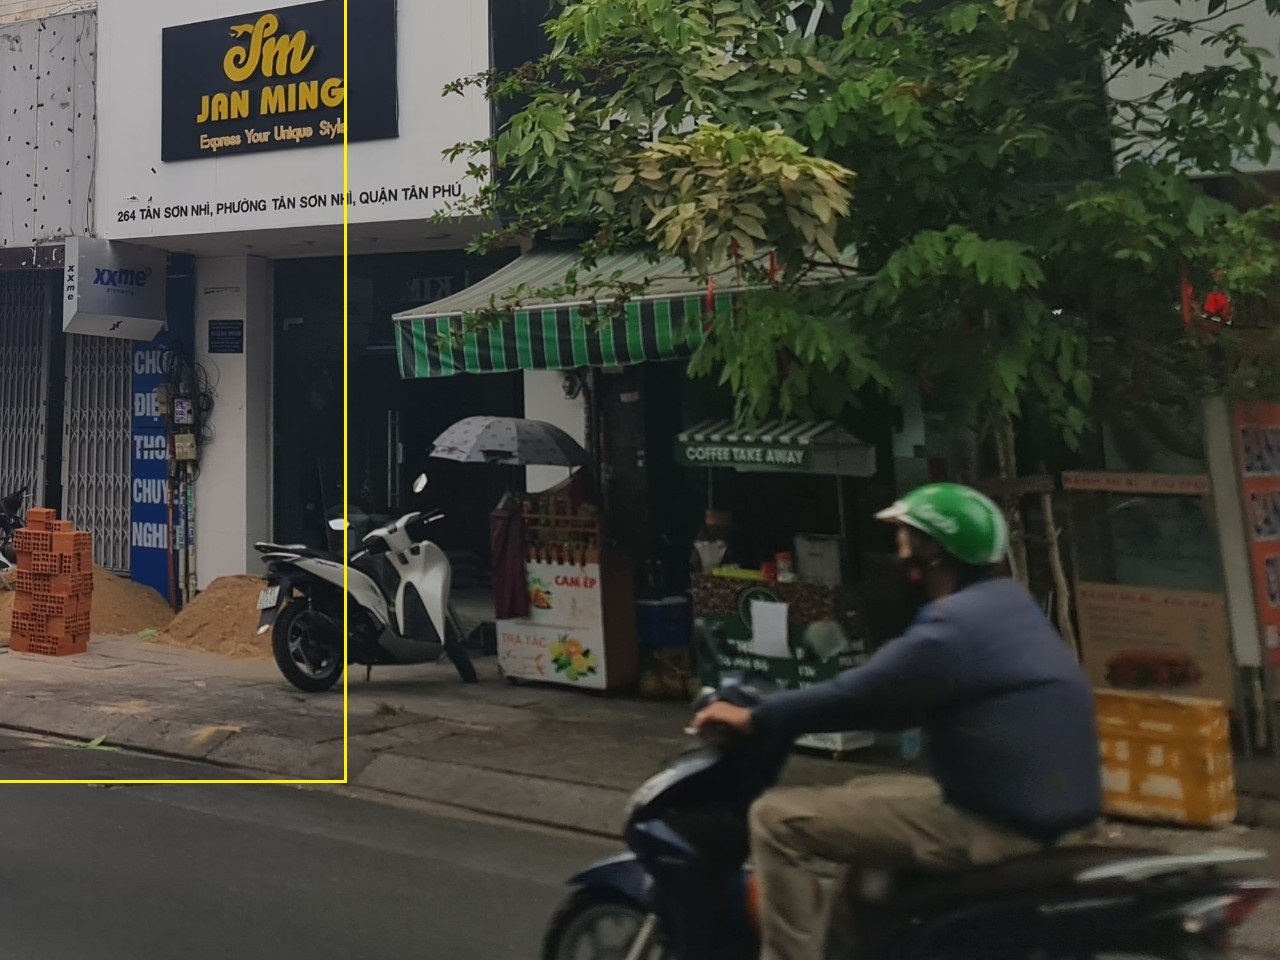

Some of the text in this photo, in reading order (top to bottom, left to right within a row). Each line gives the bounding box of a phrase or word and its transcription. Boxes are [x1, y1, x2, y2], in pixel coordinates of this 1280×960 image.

[196, 77, 345, 123] JAN MING
[200, 118, 348, 152] Express Your Unique Style
[117, 182, 462, 222] 264 TÂN SƠN NHÌ, PHƯỜNG TÂN SƠN NHÌ, QUẬN TÂN PHÚ
[133, 388, 161, 422] ĐIỆ
[133, 435, 170, 460] THO
[686, 446, 805, 465] COFFEE TAKE AWAY
[554, 575, 580, 588] CAM
